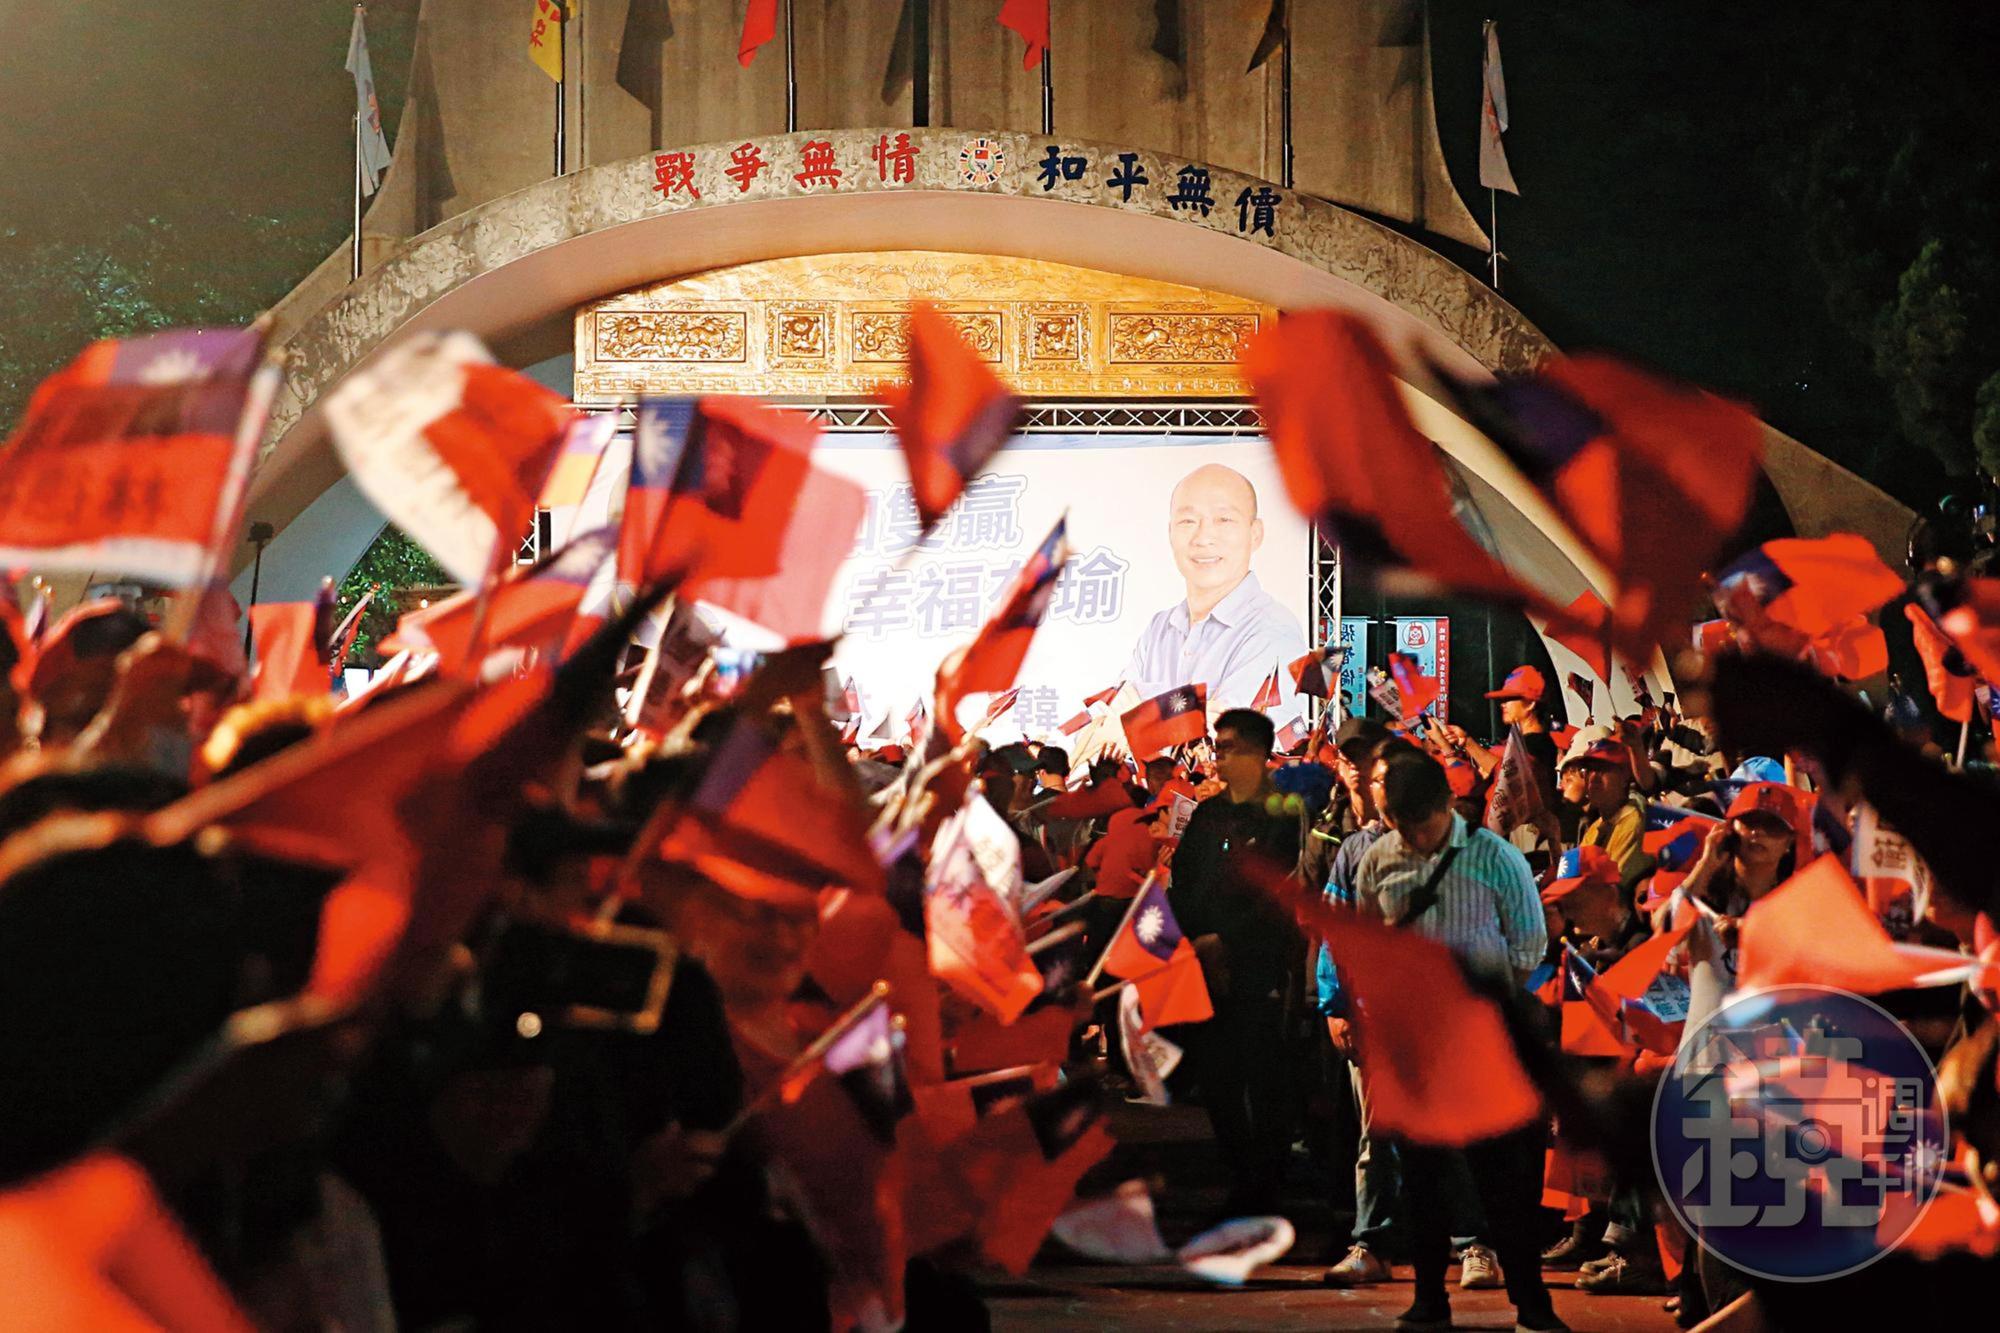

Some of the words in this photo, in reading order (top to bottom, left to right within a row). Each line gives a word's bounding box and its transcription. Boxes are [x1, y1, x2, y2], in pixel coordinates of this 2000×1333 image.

[652, 133, 920, 198] 戰爭無情
[1038, 146, 1282, 237] 和平無價
[1013, 685, 1059, 732] 韓
